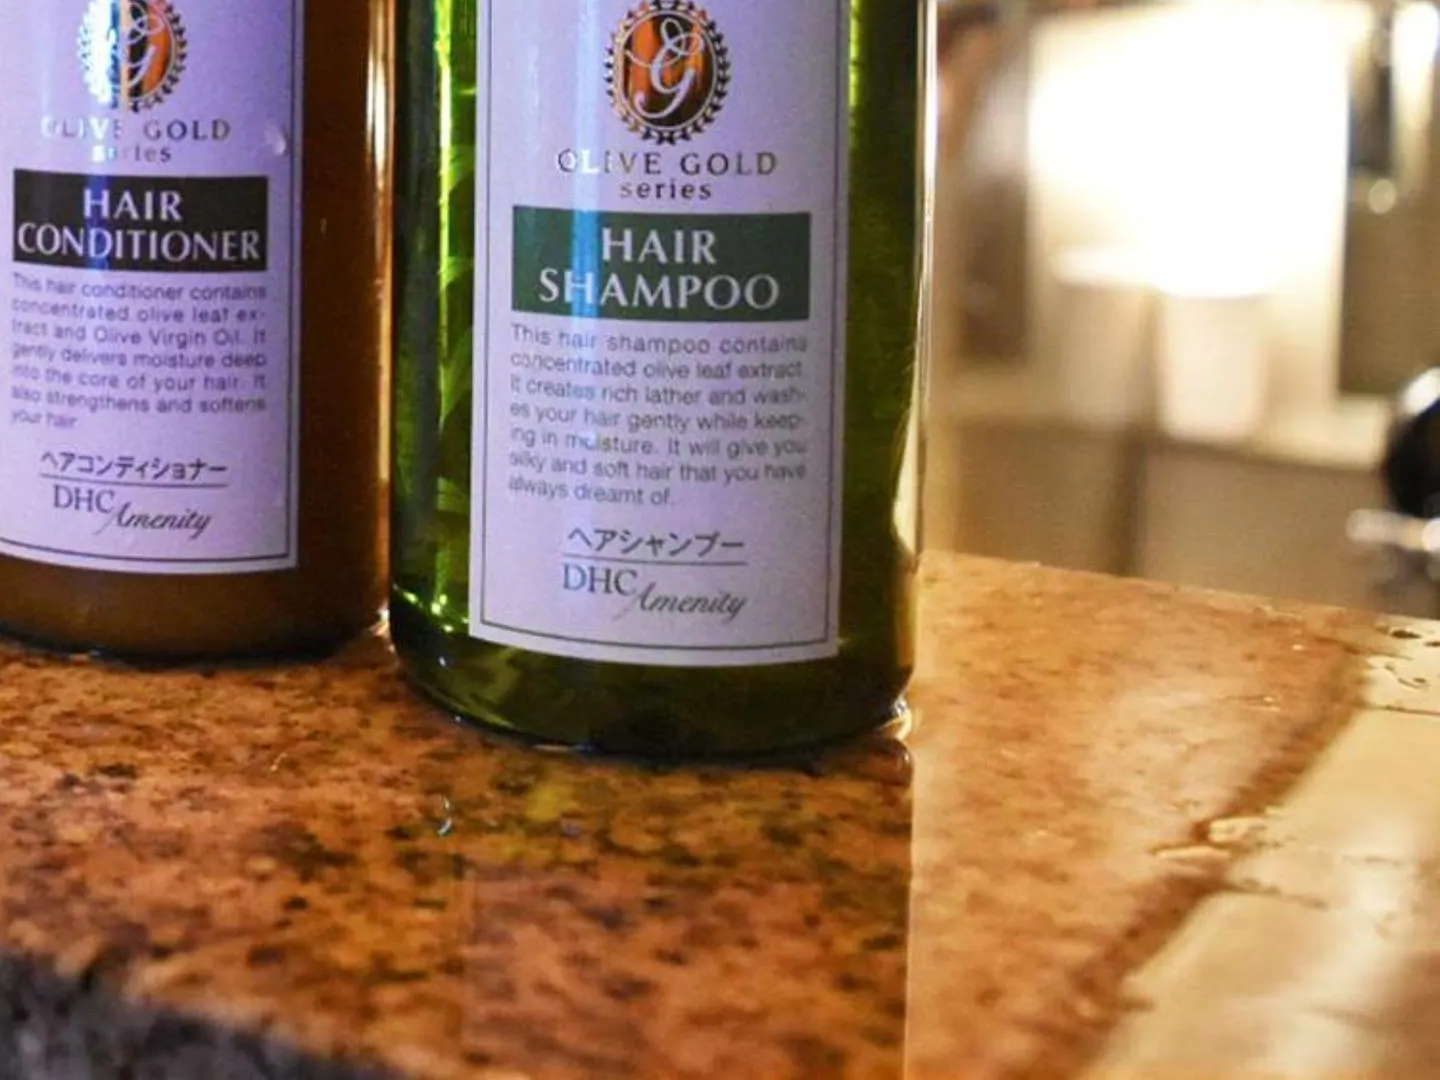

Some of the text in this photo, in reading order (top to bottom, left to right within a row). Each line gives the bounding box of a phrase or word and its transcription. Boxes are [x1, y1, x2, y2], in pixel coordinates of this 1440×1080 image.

[143, 118, 231, 142] GOLD
[557, 148, 778, 177] OLIVE GOLD
[620, 178, 712, 200] series
[83, 188, 183, 221] HAIR
[17, 222, 261, 261] CONDITIONER
[601, 227, 717, 266] HAIR
[82, 283, 183, 300] conditioner
[538, 268, 779, 310] SHAMPOO
[138, 306, 184, 322] olive
[54, 325, 86, 342] and
[149, 328, 207, 350] Virgin
[511, 321, 808, 356] This hair shampoo contains
[133, 352, 215, 368] moisture
[510, 351, 637, 378] concentrated
[643, 361, 690, 379] olive
[696, 360, 732, 379] leaf
[79, 372, 119, 389] core
[127, 375, 146, 390] of
[154, 376, 196, 393] your
[526, 377, 596, 401] creates
[602, 384, 638, 402] rich
[645, 386, 702, 405] lather
[709, 388, 745, 406] and
[157, 398, 192, 414] and
[536, 405, 577, 424] your
[583, 407, 621, 426] hair
[628, 411, 689, 435] gently
[541, 430, 558, 447] in
[688, 437, 720, 456] will
[727, 438, 769, 460] give
[550, 458, 587, 475] and
[593, 461, 630, 480] soft
[636, 462, 672, 481] hair
[680, 463, 716, 482] that
[723, 467, 759, 486] you
[764, 463, 808, 481] have
[53, 484, 116, 514] DHC
[508, 474, 568, 501] always
[574, 482, 644, 506] dreamt
[562, 564, 639, 596] DHC
